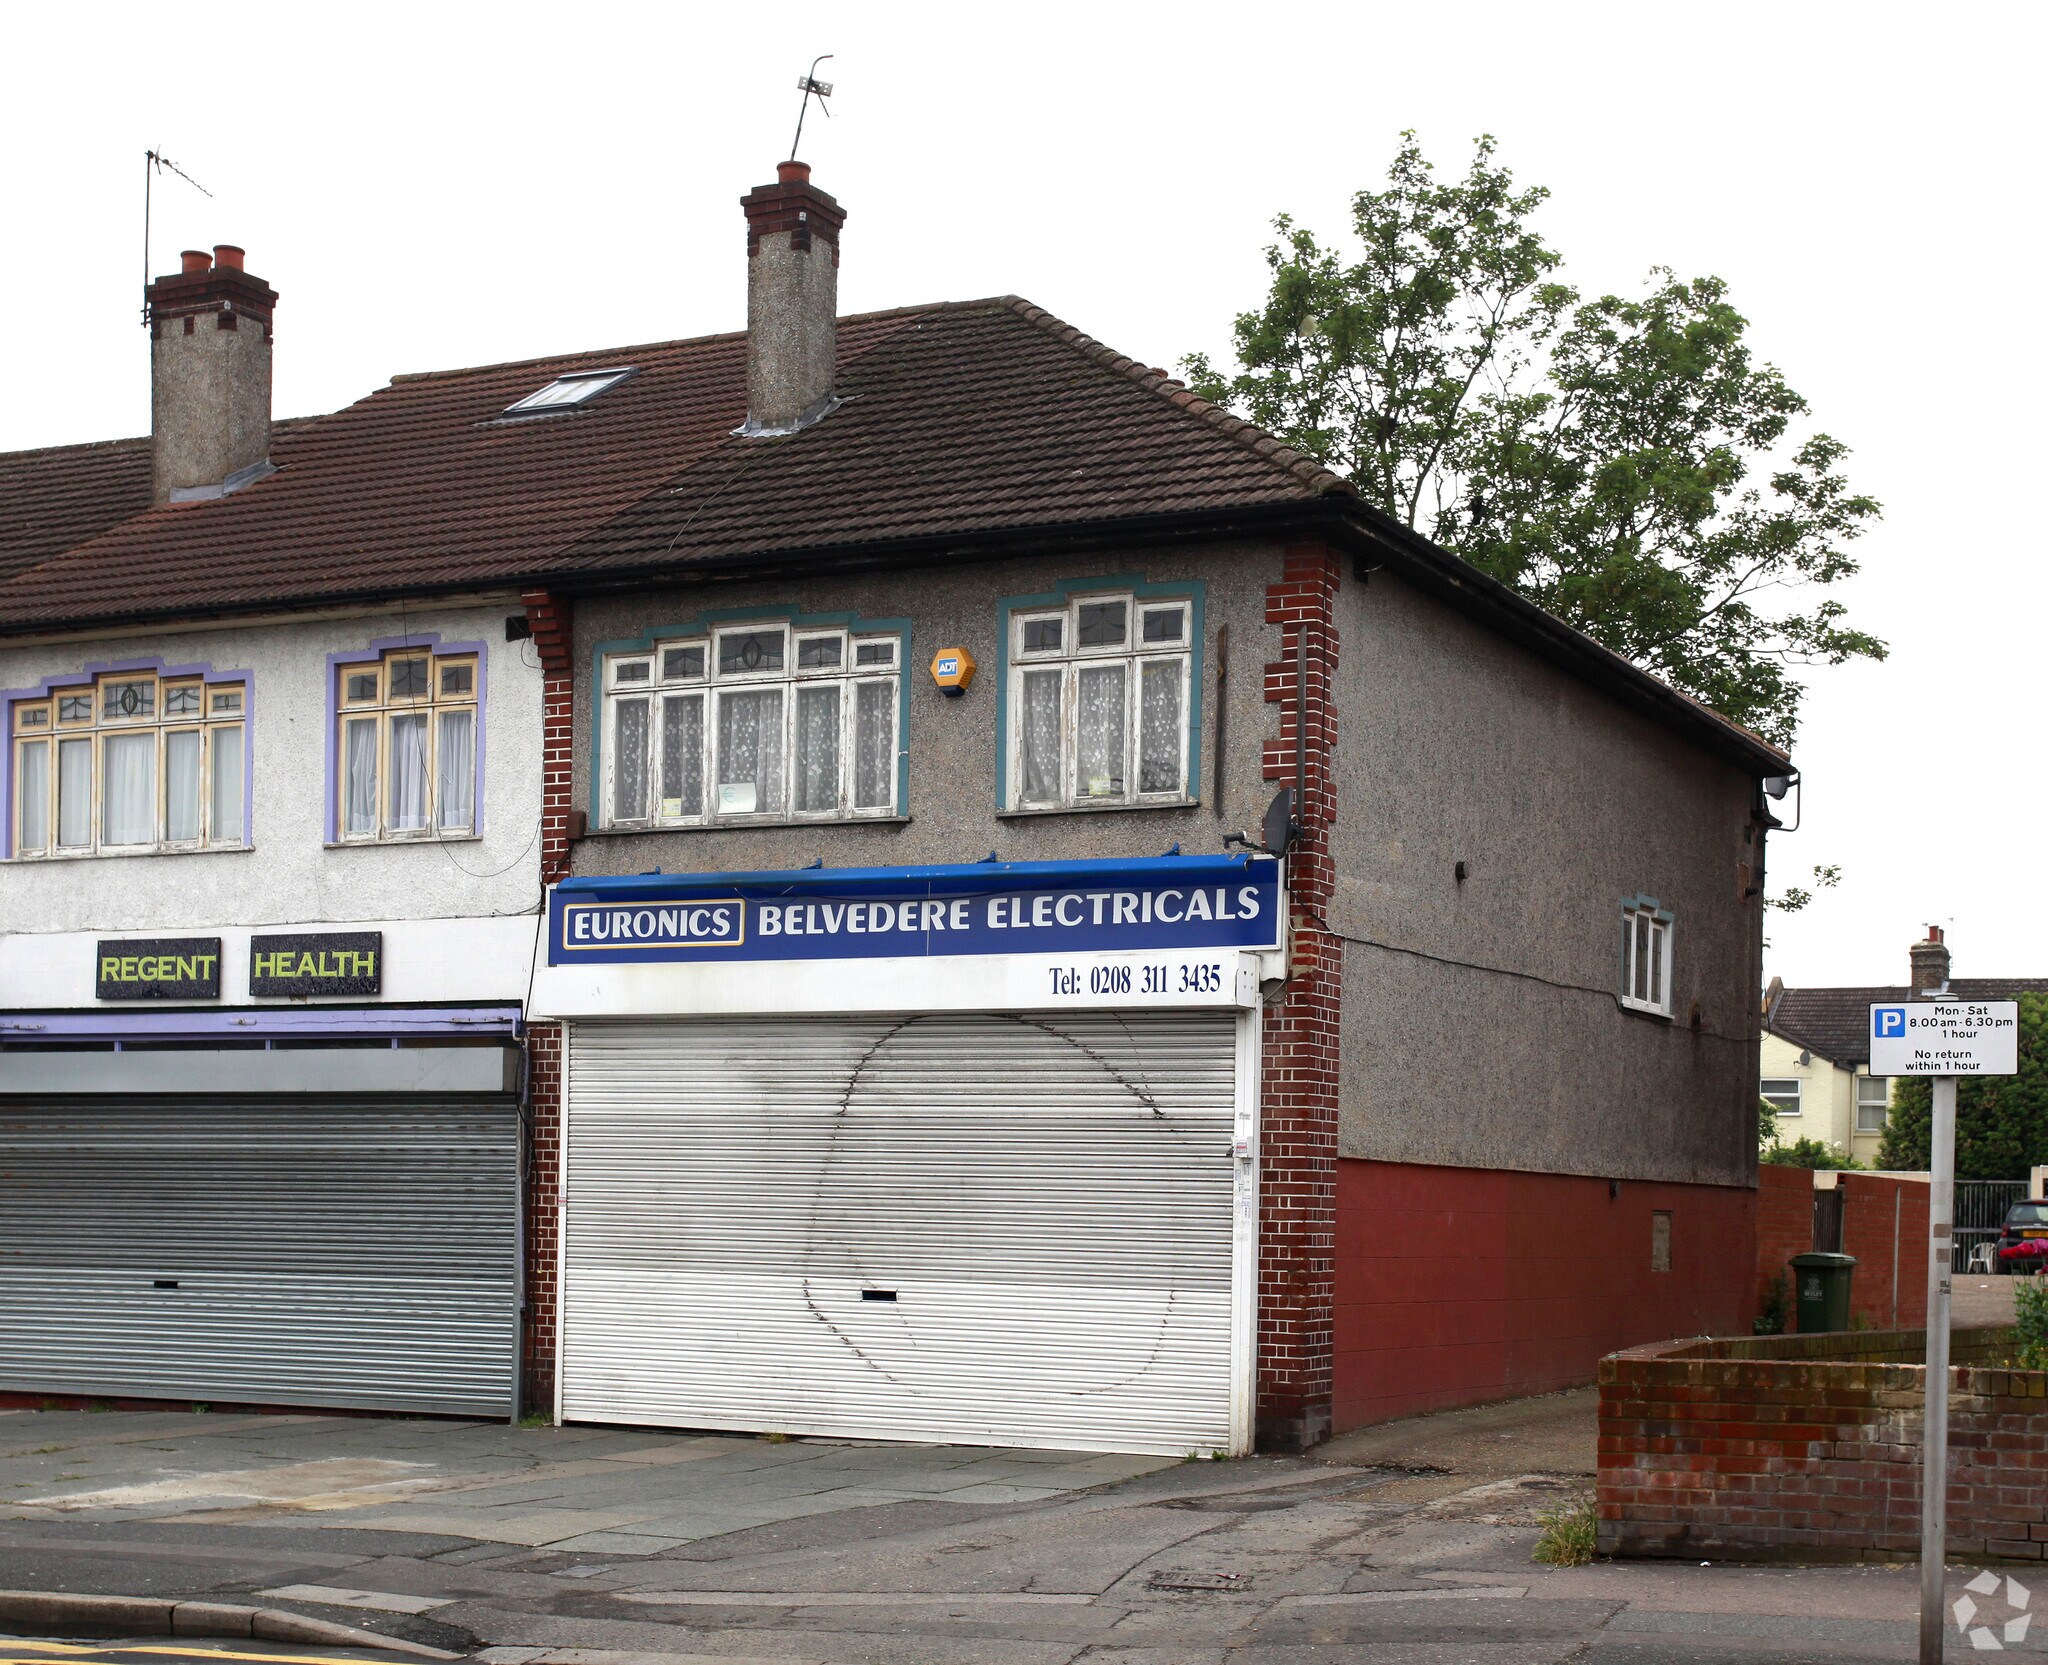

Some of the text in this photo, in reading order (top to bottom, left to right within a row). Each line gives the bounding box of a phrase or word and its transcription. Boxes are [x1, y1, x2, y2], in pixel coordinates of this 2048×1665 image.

[939, 661, 958, 673] ADT
[758, 886, 1260, 936] BELVEDERE ELECTRICALS
[574, 908, 731, 940] EURONICS
[101, 954, 217, 982] REGENT
[254, 950, 375, 978] HEALTH
[1049, 964, 1221, 995] Tel: 0208 311 3435
[1934, 1006, 1960, 1016] Mon
[1967, 1005, 1988, 1016] Sat
[1951, 1029, 1978, 1039] hour
[1914, 1049, 1972, 1059] No return
[1905, 1061, 1941, 1071] within
[1954, 1060, 1981, 1071] hour
